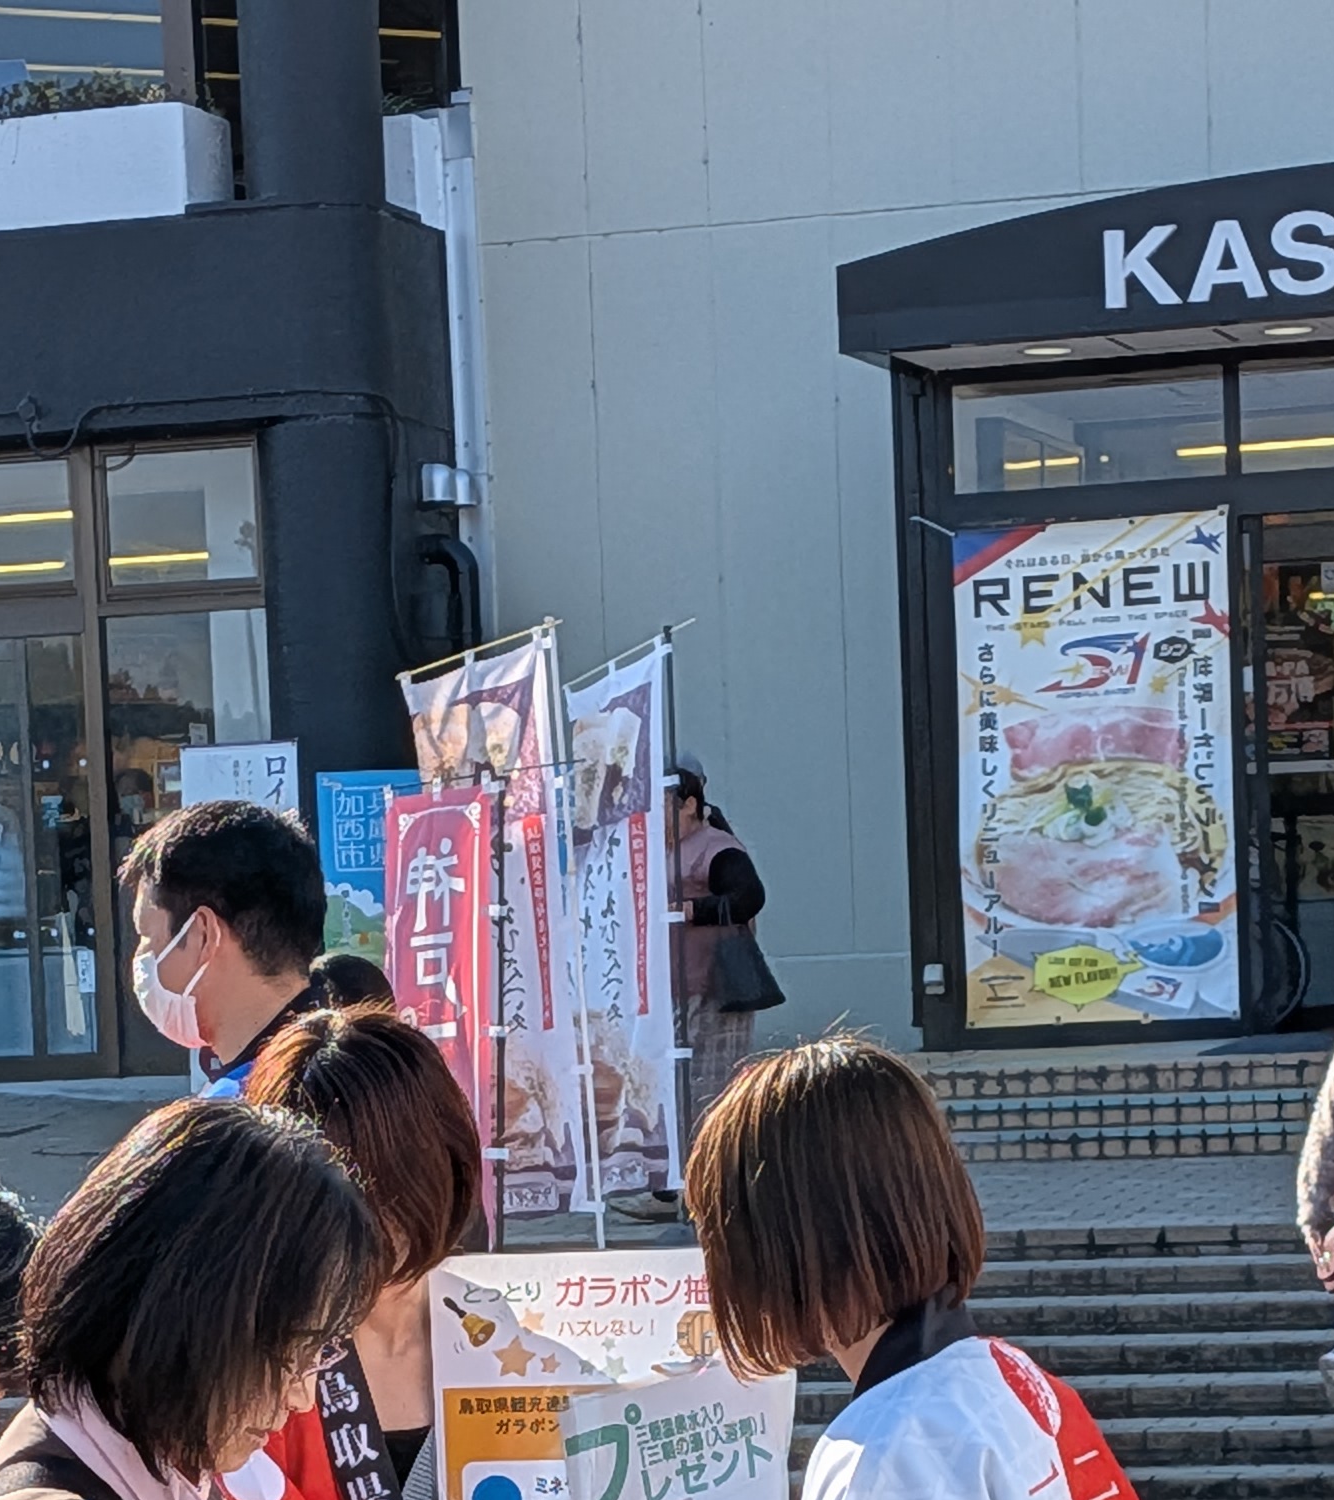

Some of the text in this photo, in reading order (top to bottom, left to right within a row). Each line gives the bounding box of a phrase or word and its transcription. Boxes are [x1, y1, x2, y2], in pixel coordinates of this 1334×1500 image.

[972, 560, 1211, 619] RENEW
[336, 793, 365, 869] 加西市
